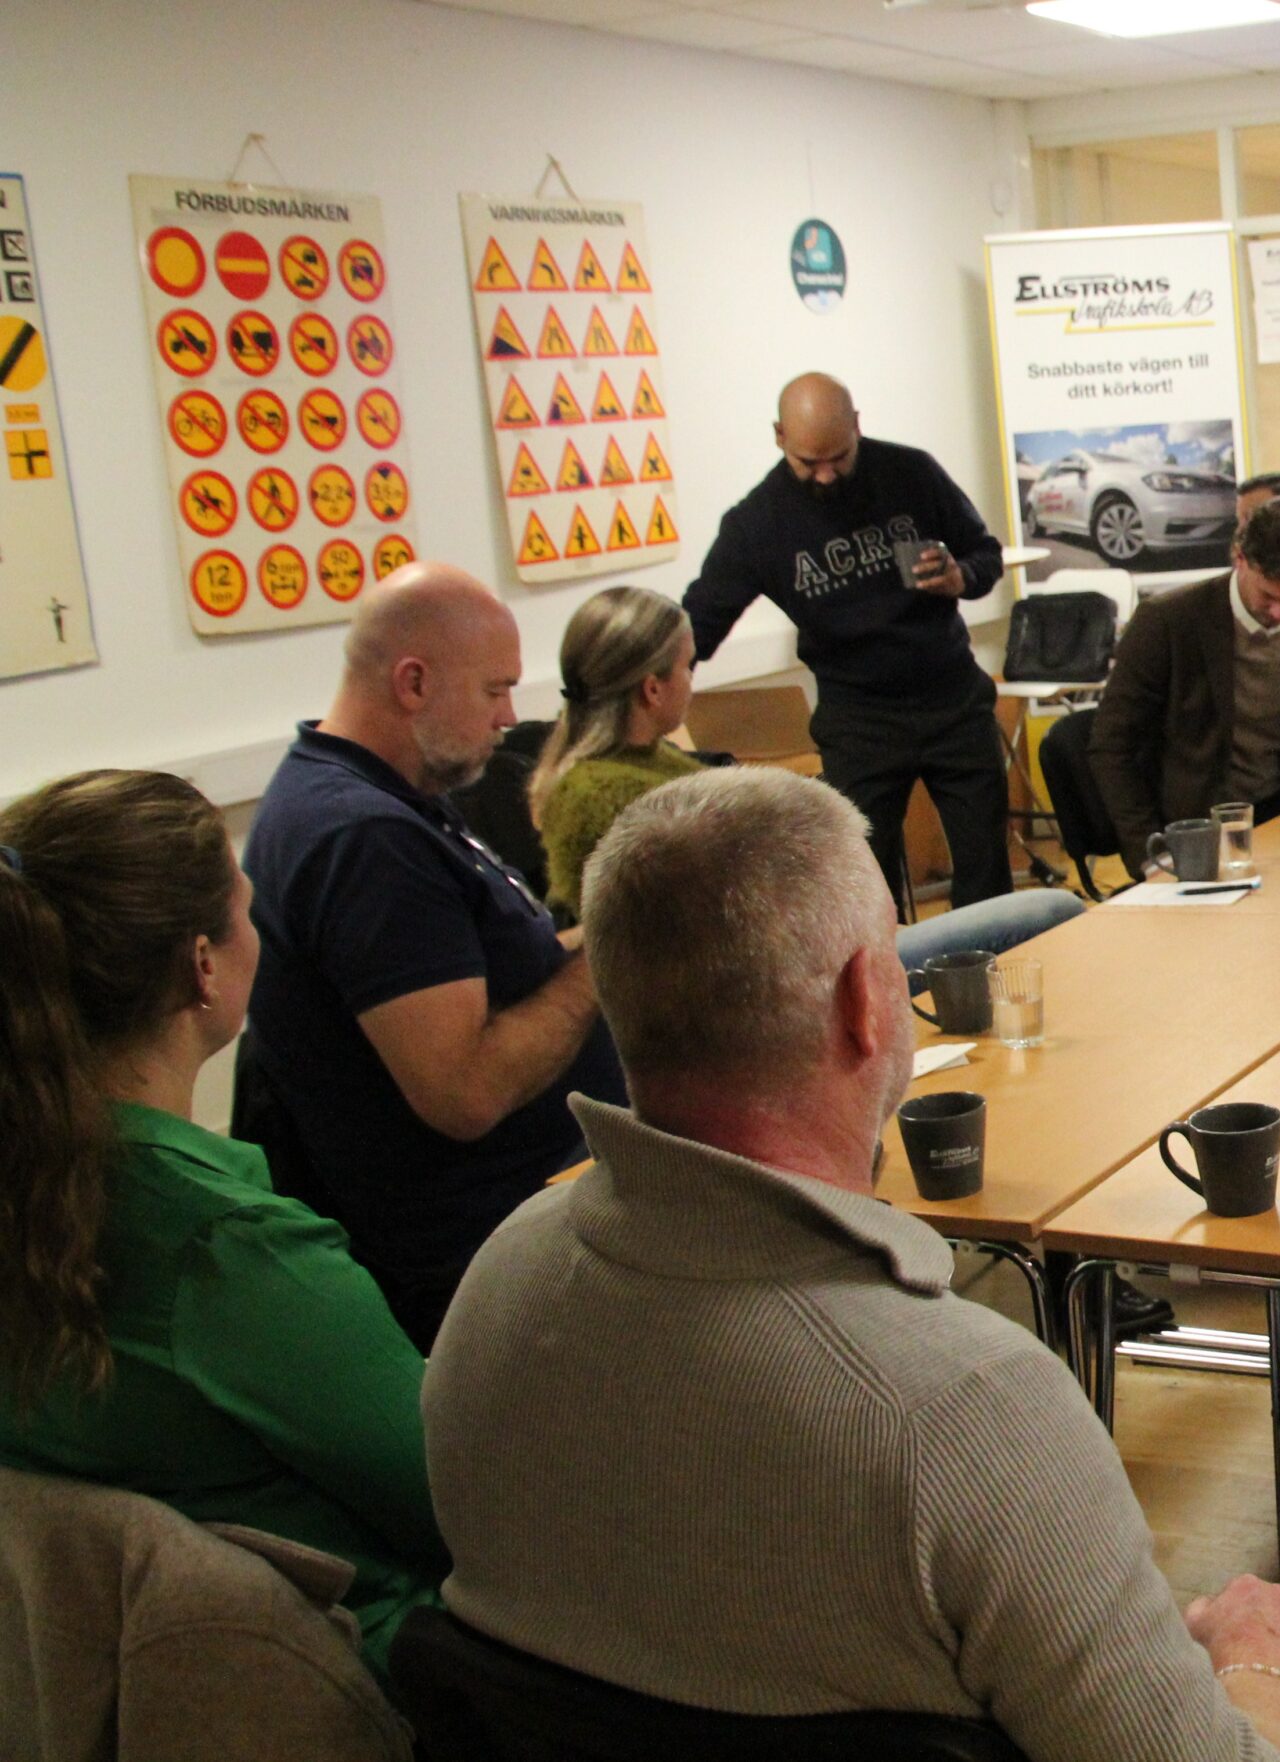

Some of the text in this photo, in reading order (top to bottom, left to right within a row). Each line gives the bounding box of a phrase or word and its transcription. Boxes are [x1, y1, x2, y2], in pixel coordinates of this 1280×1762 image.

[1027, 353, 1209, 379] Snabbaste vägen till
[1067, 378, 1174, 400] ditt körkort!
[207, 564, 232, 587] 12
